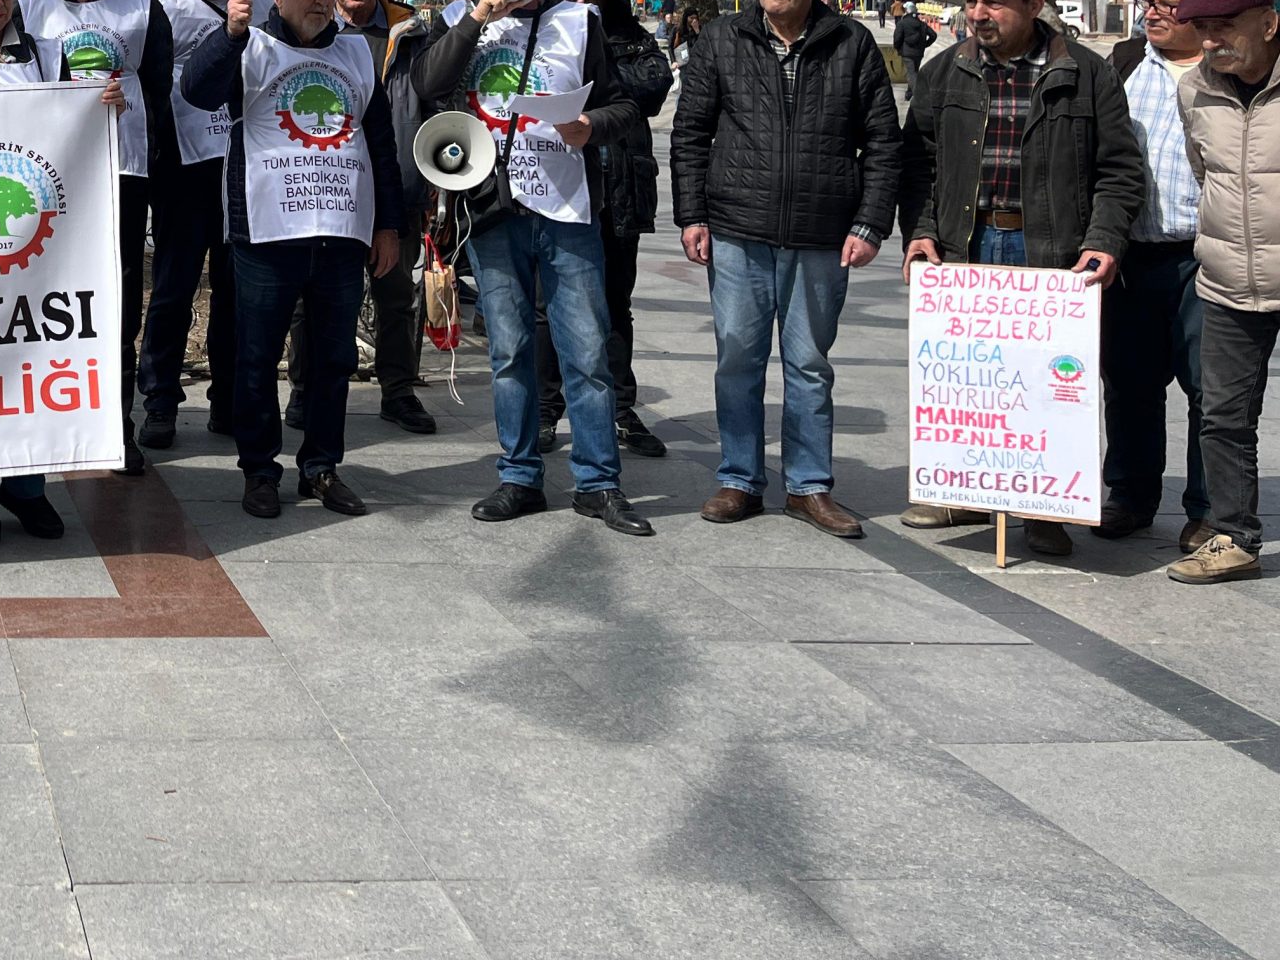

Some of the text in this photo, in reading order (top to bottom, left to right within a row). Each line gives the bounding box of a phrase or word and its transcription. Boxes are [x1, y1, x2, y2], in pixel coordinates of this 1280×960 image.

[311, 127, 332, 135] 2017
[262, 155, 366, 173] TÜM EMEKLİLERİN
[26, 150, 67, 215] SENDİKASI
[284, 171, 350, 185] SENDİKASI
[286, 184, 352, 198] BANDIRMA
[920, 266, 1087, 294] SENDİKALI OLU
[945, 316, 1052, 341] BİZLERİ
[918, 361, 1028, 392] YOKLUĞA
[916, 405, 1012, 430] MAHKUM
[914, 426, 1047, 452] EDENLERİ
[915, 488, 938, 499] TÜM
